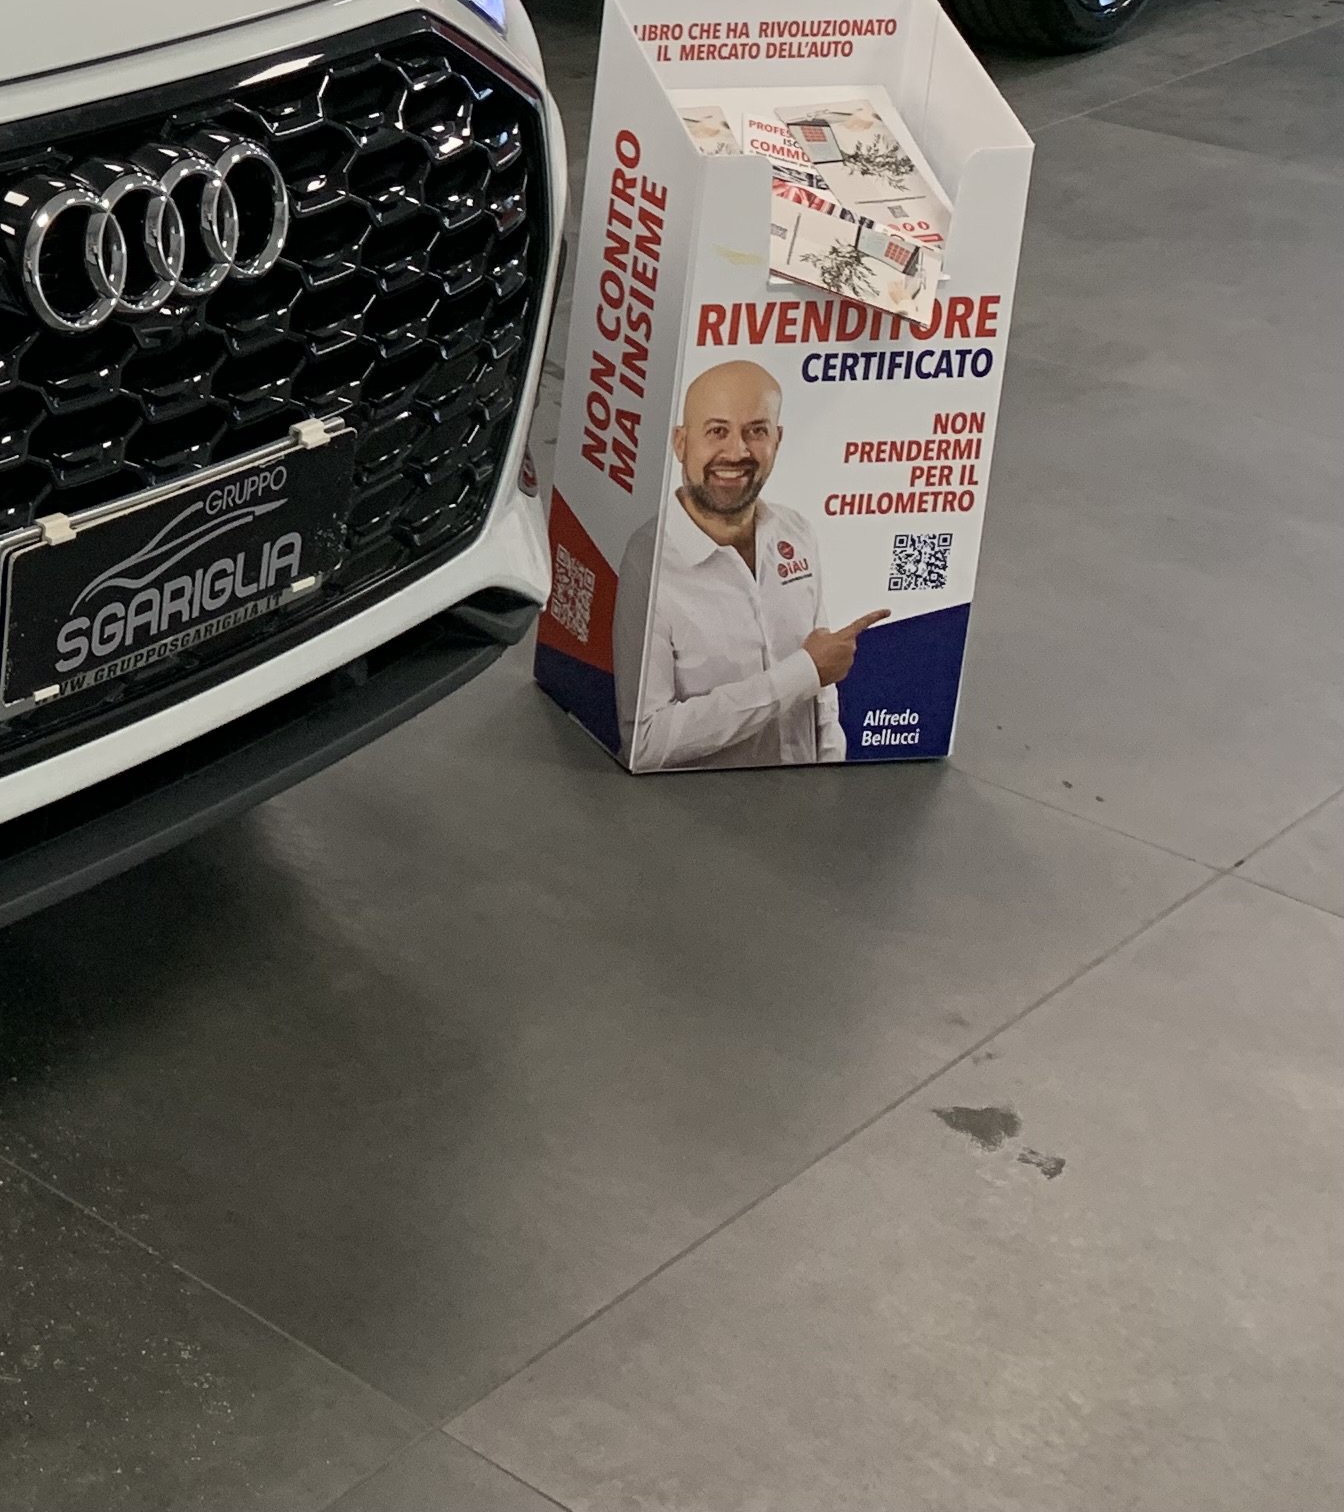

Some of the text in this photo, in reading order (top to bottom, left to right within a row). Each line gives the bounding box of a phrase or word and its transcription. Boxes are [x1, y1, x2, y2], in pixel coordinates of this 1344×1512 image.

[688, 23, 722, 40] CHE
[725, 22, 750, 39] HA
[758, 18, 897, 38] RIVOLUZIONATO
[656, 40, 854, 62] IL MERCATO DELL'AUTO
[581, 129, 641, 473] NON CONTRO
[608, 174, 668, 495] MA INSIEME
[801, 347, 993, 383] CERTIFICATO
[933, 411, 986, 435] NON
[844, 438, 982, 464] PRENDERMI
[909, 464, 979, 487] PER IL
[206, 465, 288, 515] GRUPPO
[824, 489, 975, 516] CHILOMETRO
[55, 532, 303, 673] SGARIGLIA
[35, 592, 282, 705] W.GRUPPOSGARIGLIA.IT
[863, 708, 919, 727] Alfredo
[861, 728, 920, 747] Bellucci
